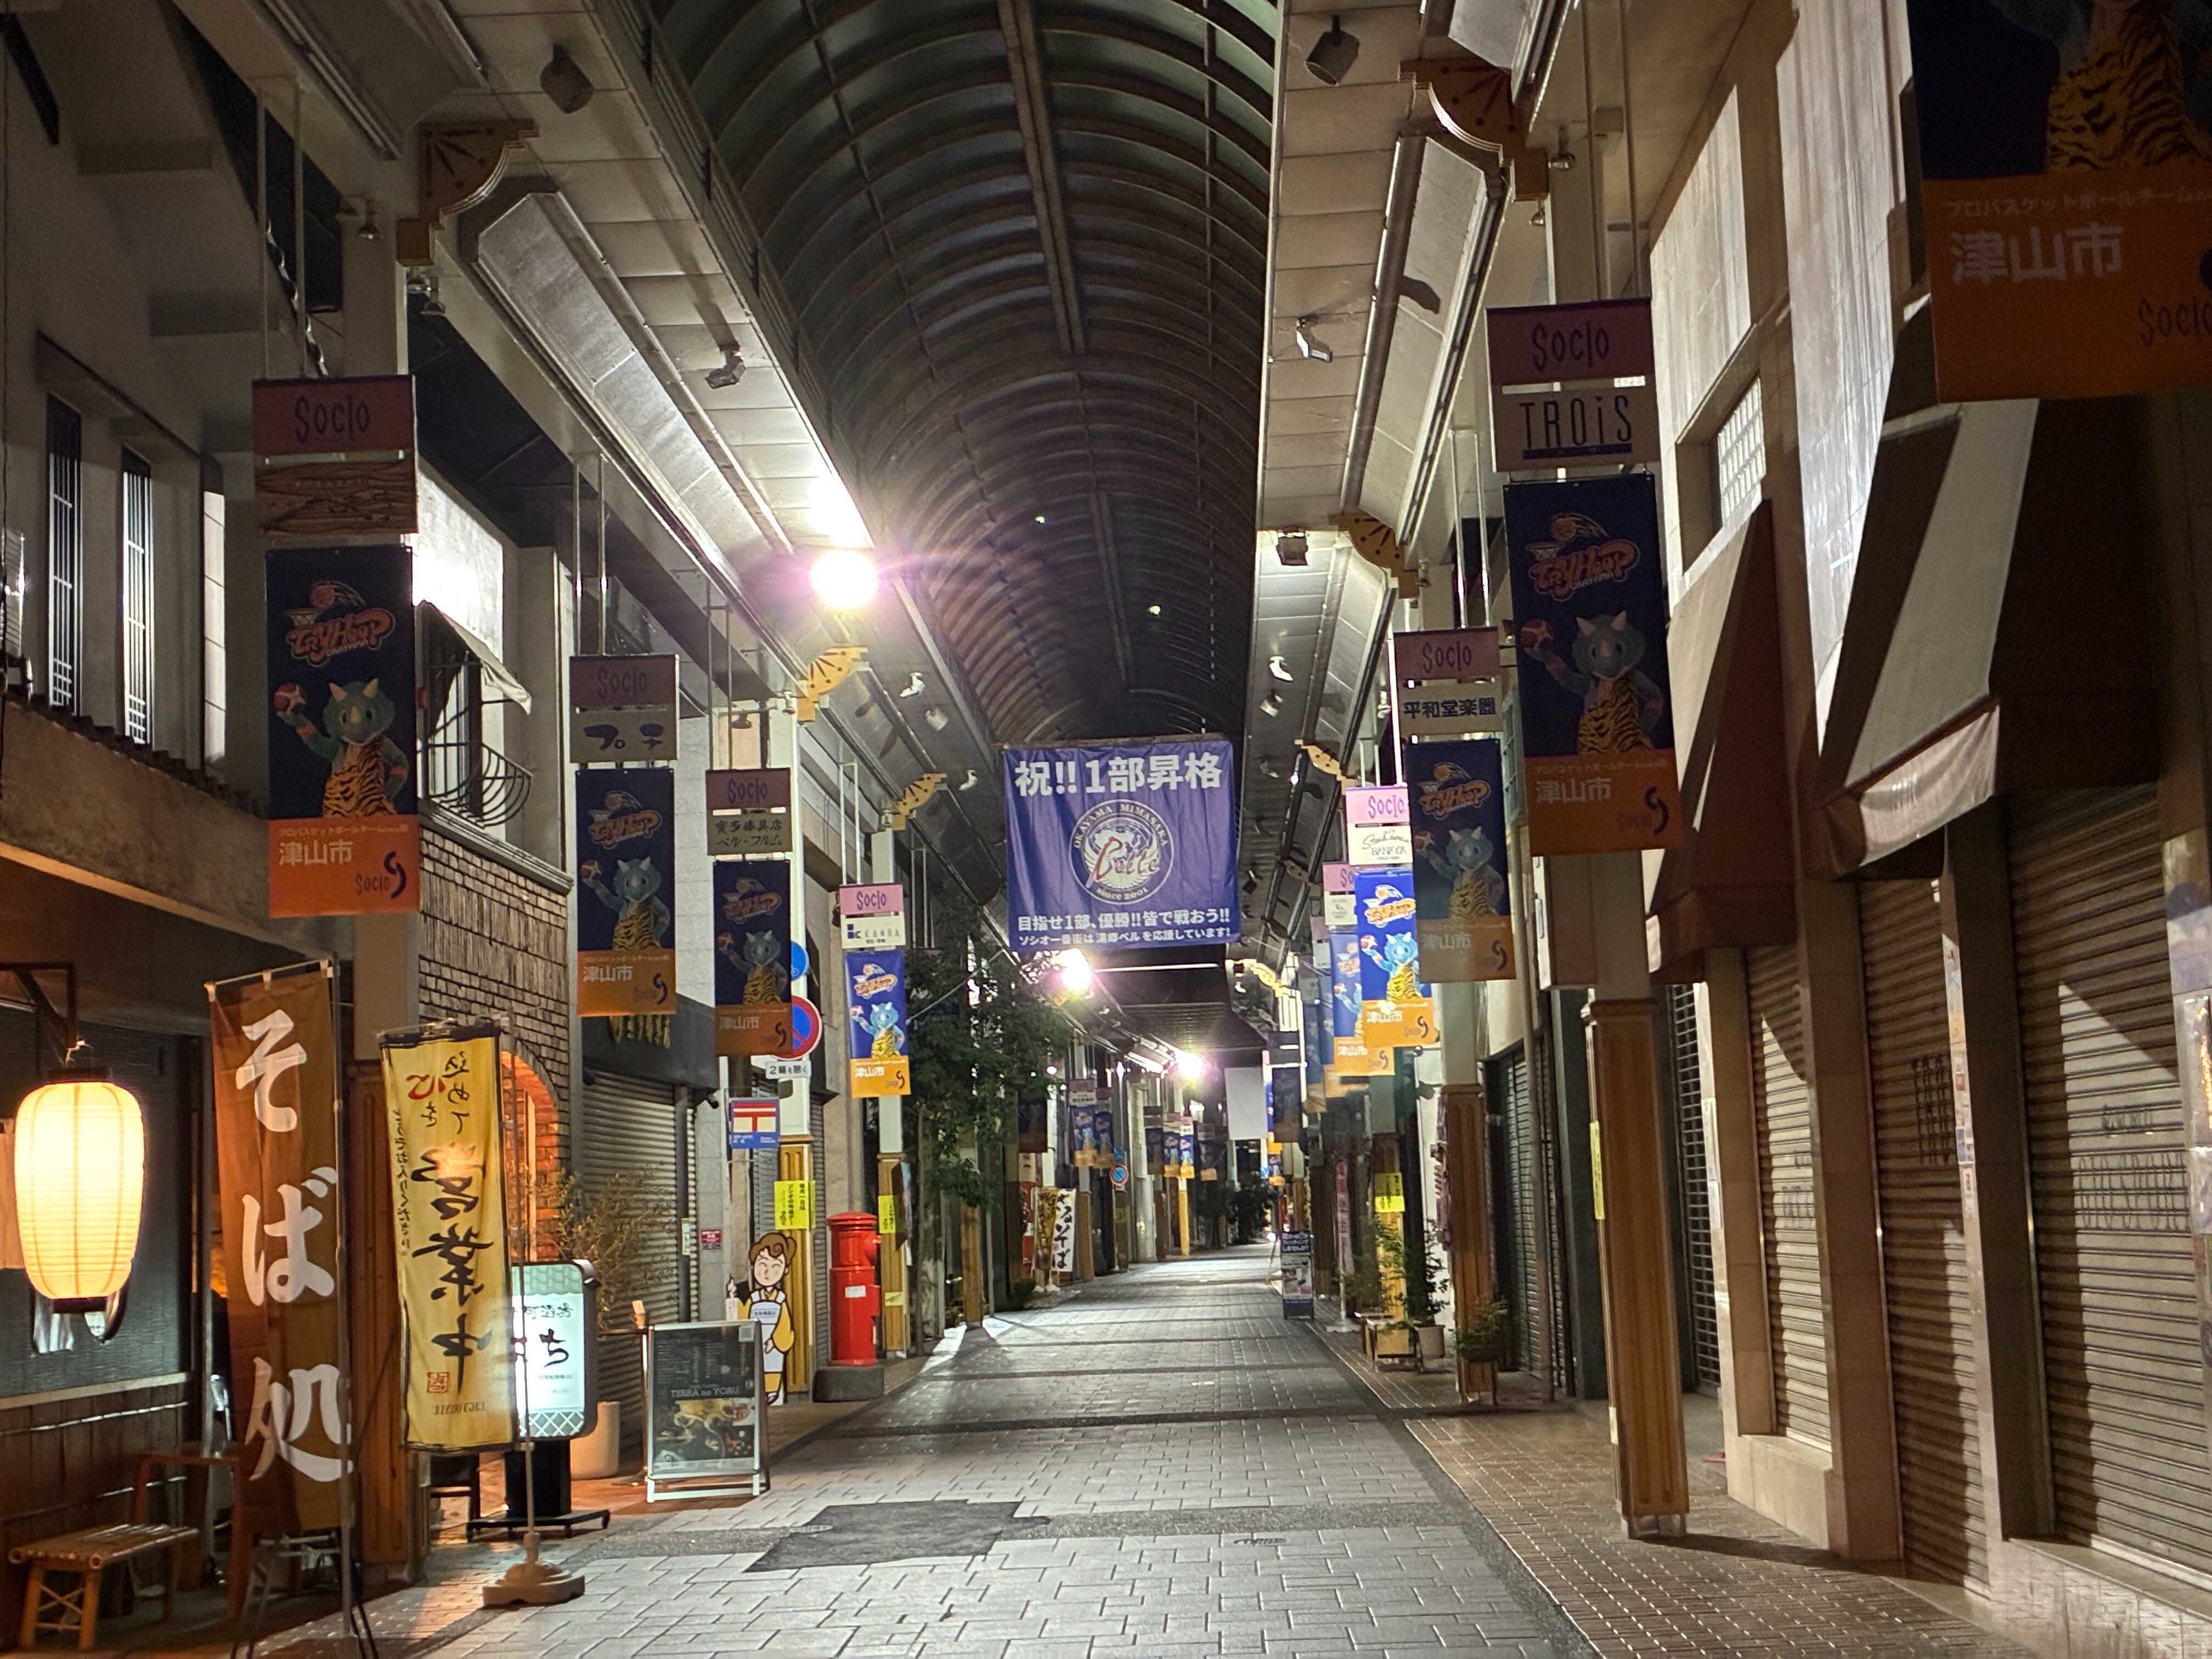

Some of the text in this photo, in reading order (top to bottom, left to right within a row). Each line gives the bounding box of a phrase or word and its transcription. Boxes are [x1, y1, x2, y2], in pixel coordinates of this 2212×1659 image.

[1949, 222, 2125, 285] 津山市
[1532, 322, 1609, 373] Socio
[295, 395, 370, 444] Socio
[1423, 641, 1472, 674] Socio
[1403, 697, 1496, 719] 平和堂楽器
[1536, 776, 1612, 804] 津山市
[1368, 794, 1405, 819] Socio
[278, 838, 353, 867] 津山市
[856, 890, 887, 911] Socio
[583, 965, 634, 983] 津山市
[235, 1008, 353, 1482] そば処
